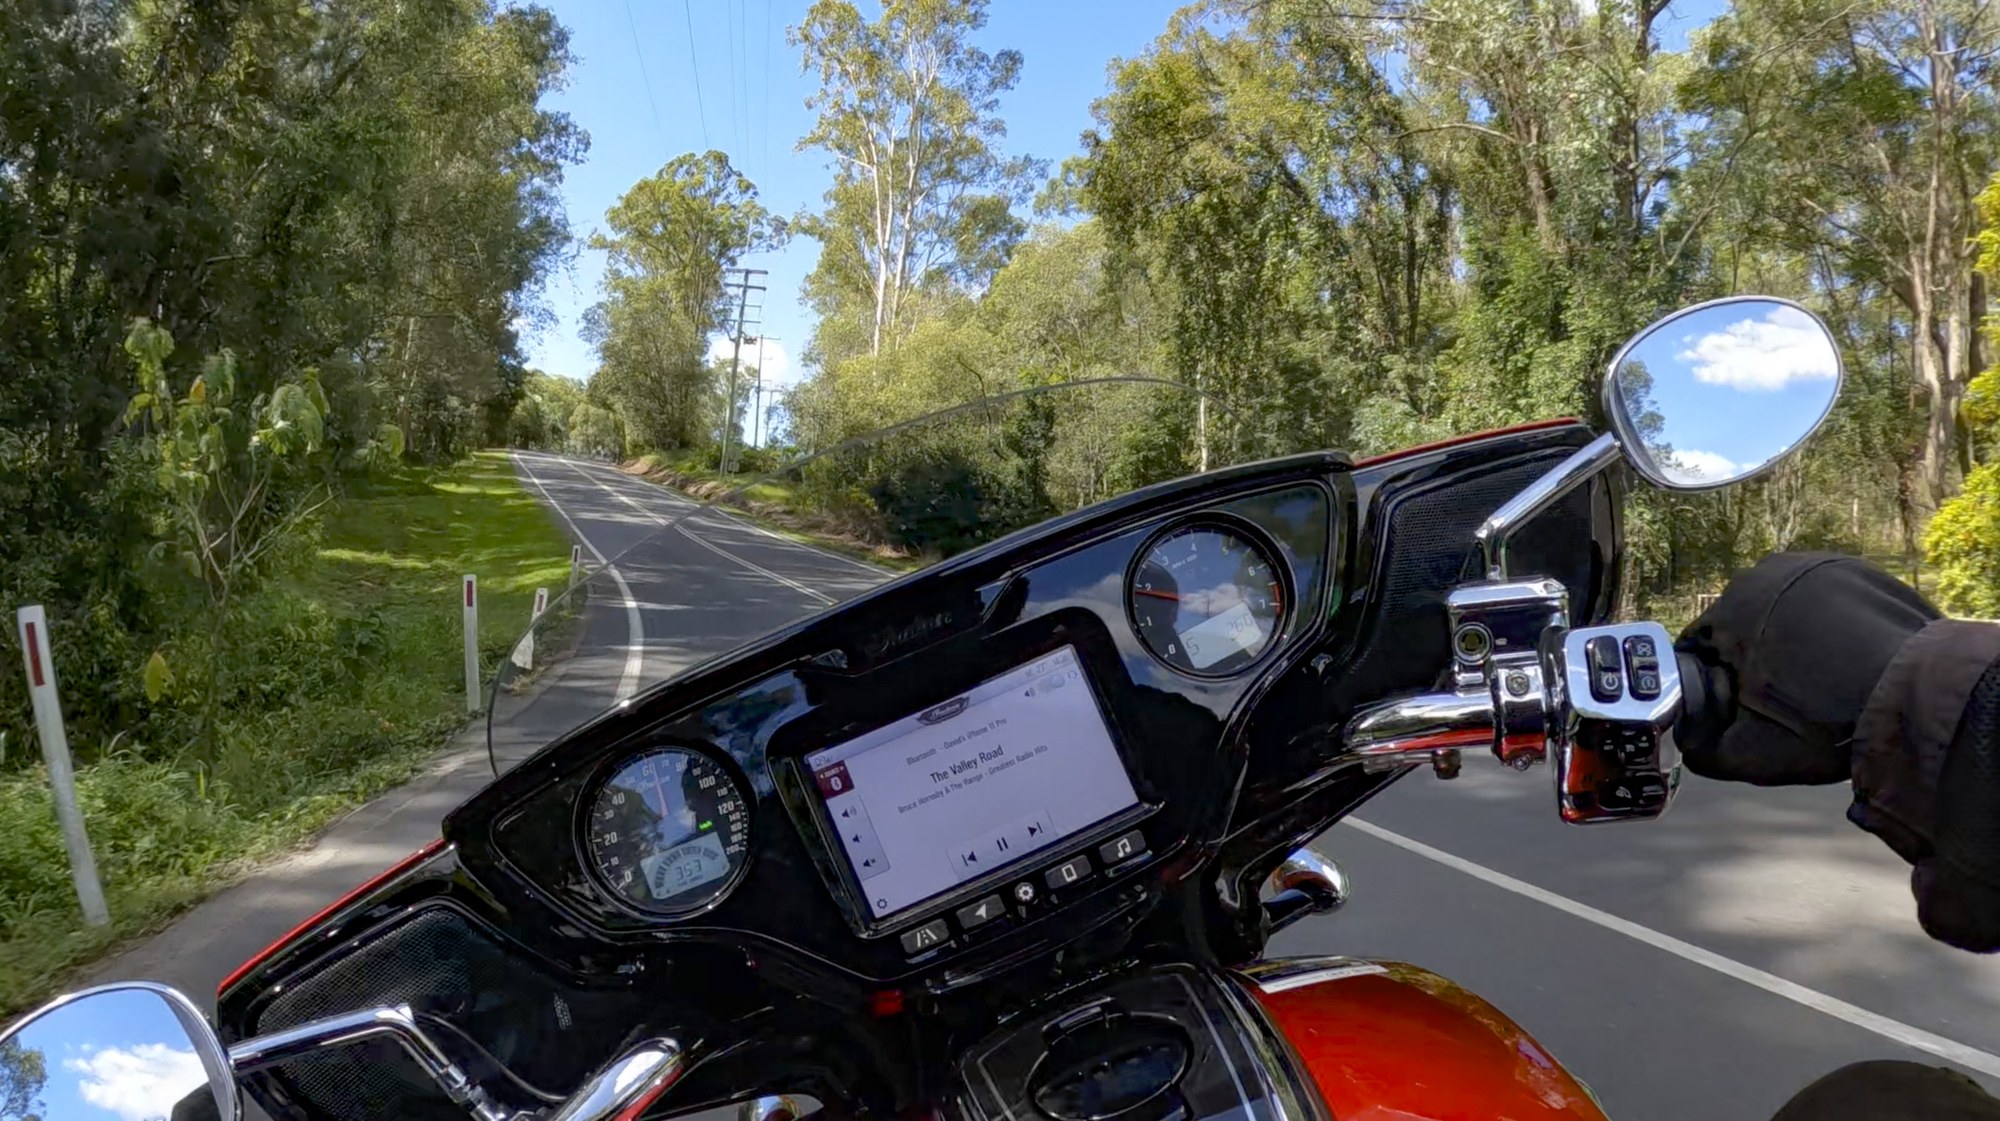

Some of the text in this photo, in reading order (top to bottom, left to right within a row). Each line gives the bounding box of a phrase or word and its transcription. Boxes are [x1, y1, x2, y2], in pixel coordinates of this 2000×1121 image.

[1222, 547, 1229, 555] 5
[1162, 556, 1169, 566] 3
[1259, 599, 1265, 609] 7
[1146, 616, 1152, 626] 1
[1168, 644, 1176, 654] 0
[1185, 637, 1199, 656] 5
[906, 748, 937, 766] Bluetooth
[943, 736, 966, 750] David's
[967, 726, 988, 740] iPhone
[989, 721, 996, 730] 11
[996, 718, 1007, 728] Pro
[930, 744, 1004, 784] The Valley Road
[699, 775, 715, 790] 100
[898, 800, 918, 814] Bruce
[918, 789, 944, 806] Hornsby
[945, 786, 951, 794] &
[950, 780, 963, 791] The
[963, 773, 983, 786] Range
[988, 758, 1016, 775] Greatest
[1015, 751, 1034, 763] Radio
[1034, 744, 1048, 756] Hits
[717, 787, 728, 797] 110
[612, 792, 625, 806] 40
[717, 800, 734, 815] 120
[604, 809, 614, 819] 30
[604, 832, 617, 846] 20
[610, 856, 619, 866] 10
[624, 870, 632, 882] 0
